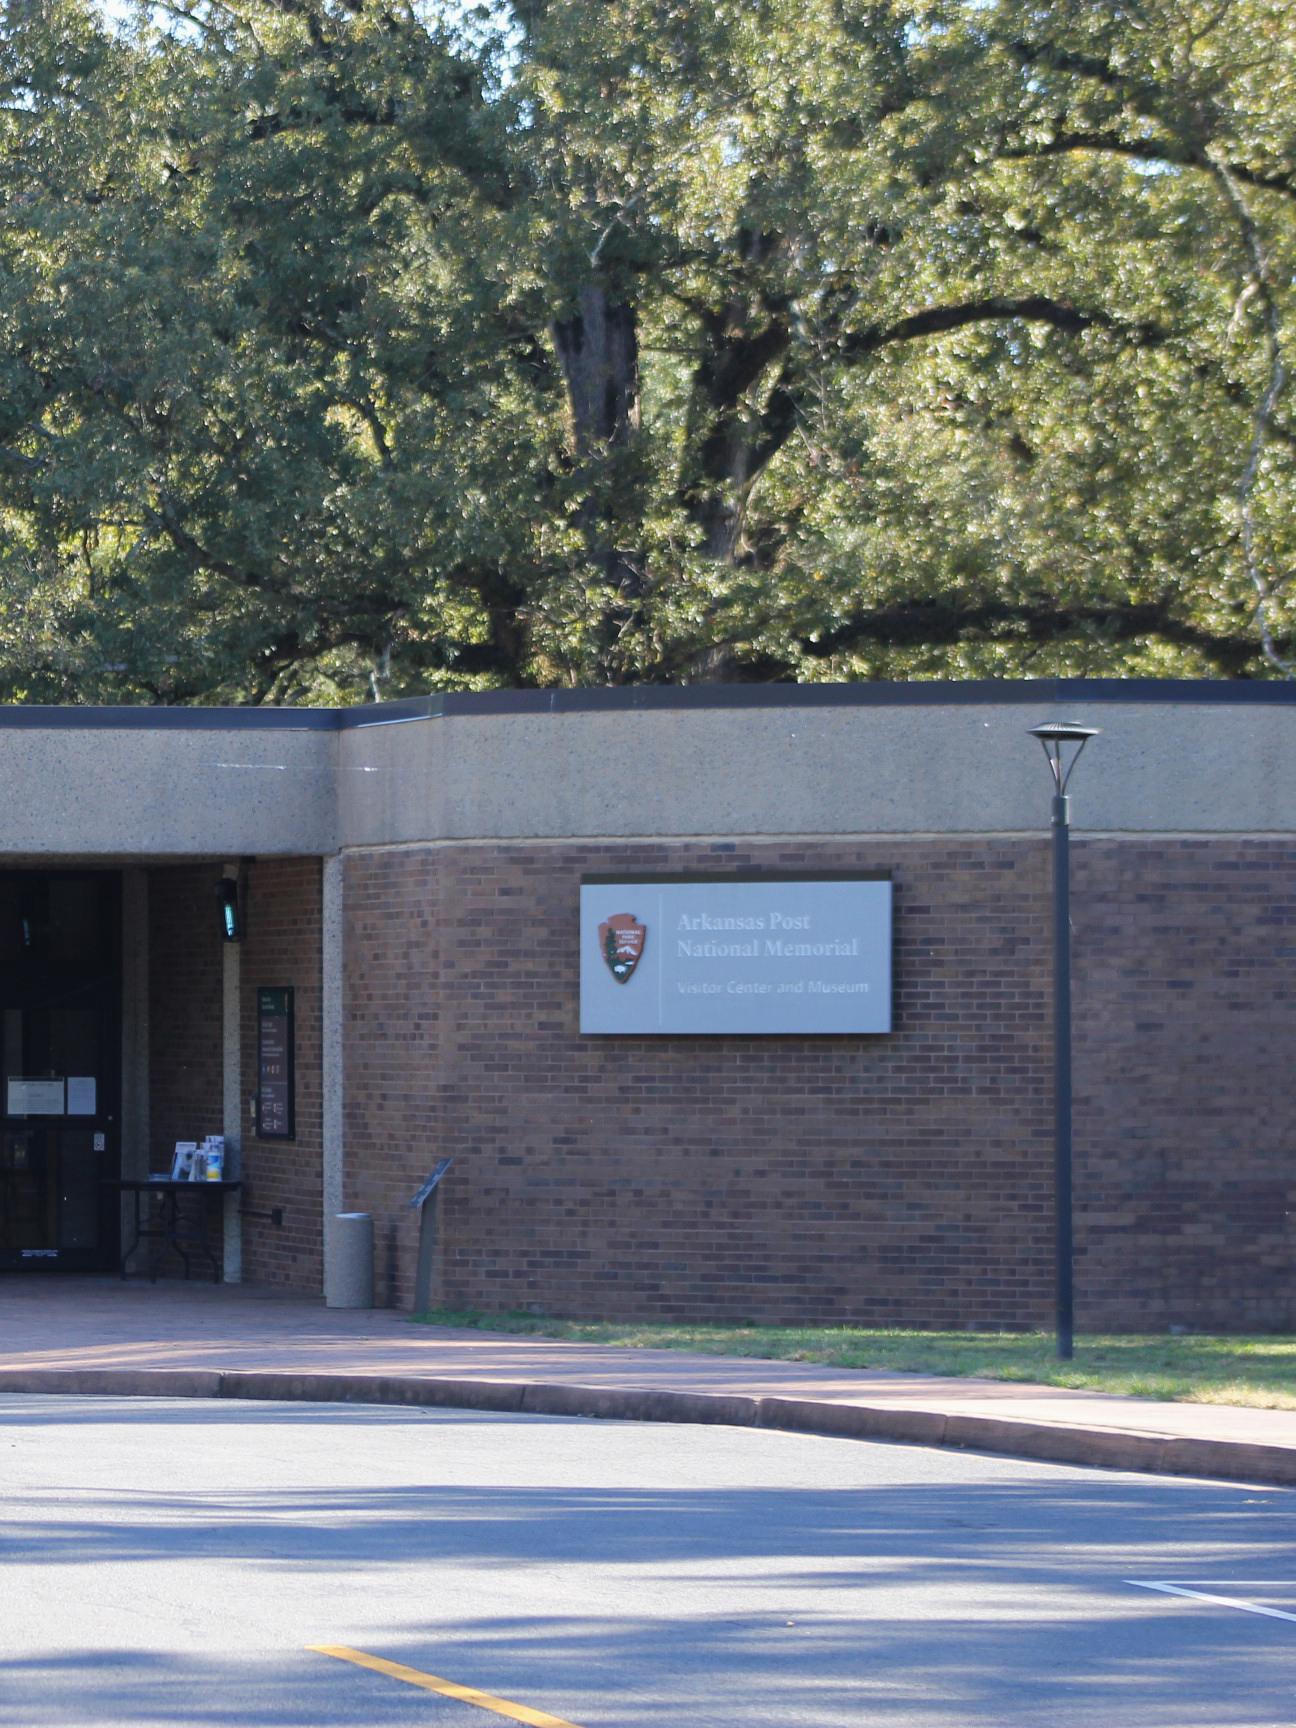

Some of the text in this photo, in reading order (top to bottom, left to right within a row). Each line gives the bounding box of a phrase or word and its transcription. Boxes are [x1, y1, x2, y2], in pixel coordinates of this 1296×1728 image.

[676, 910, 811, 930] Arkansas Post
[677, 938, 859, 957] National Memorial
[677, 980, 869, 994] Visitor Center and Museum
